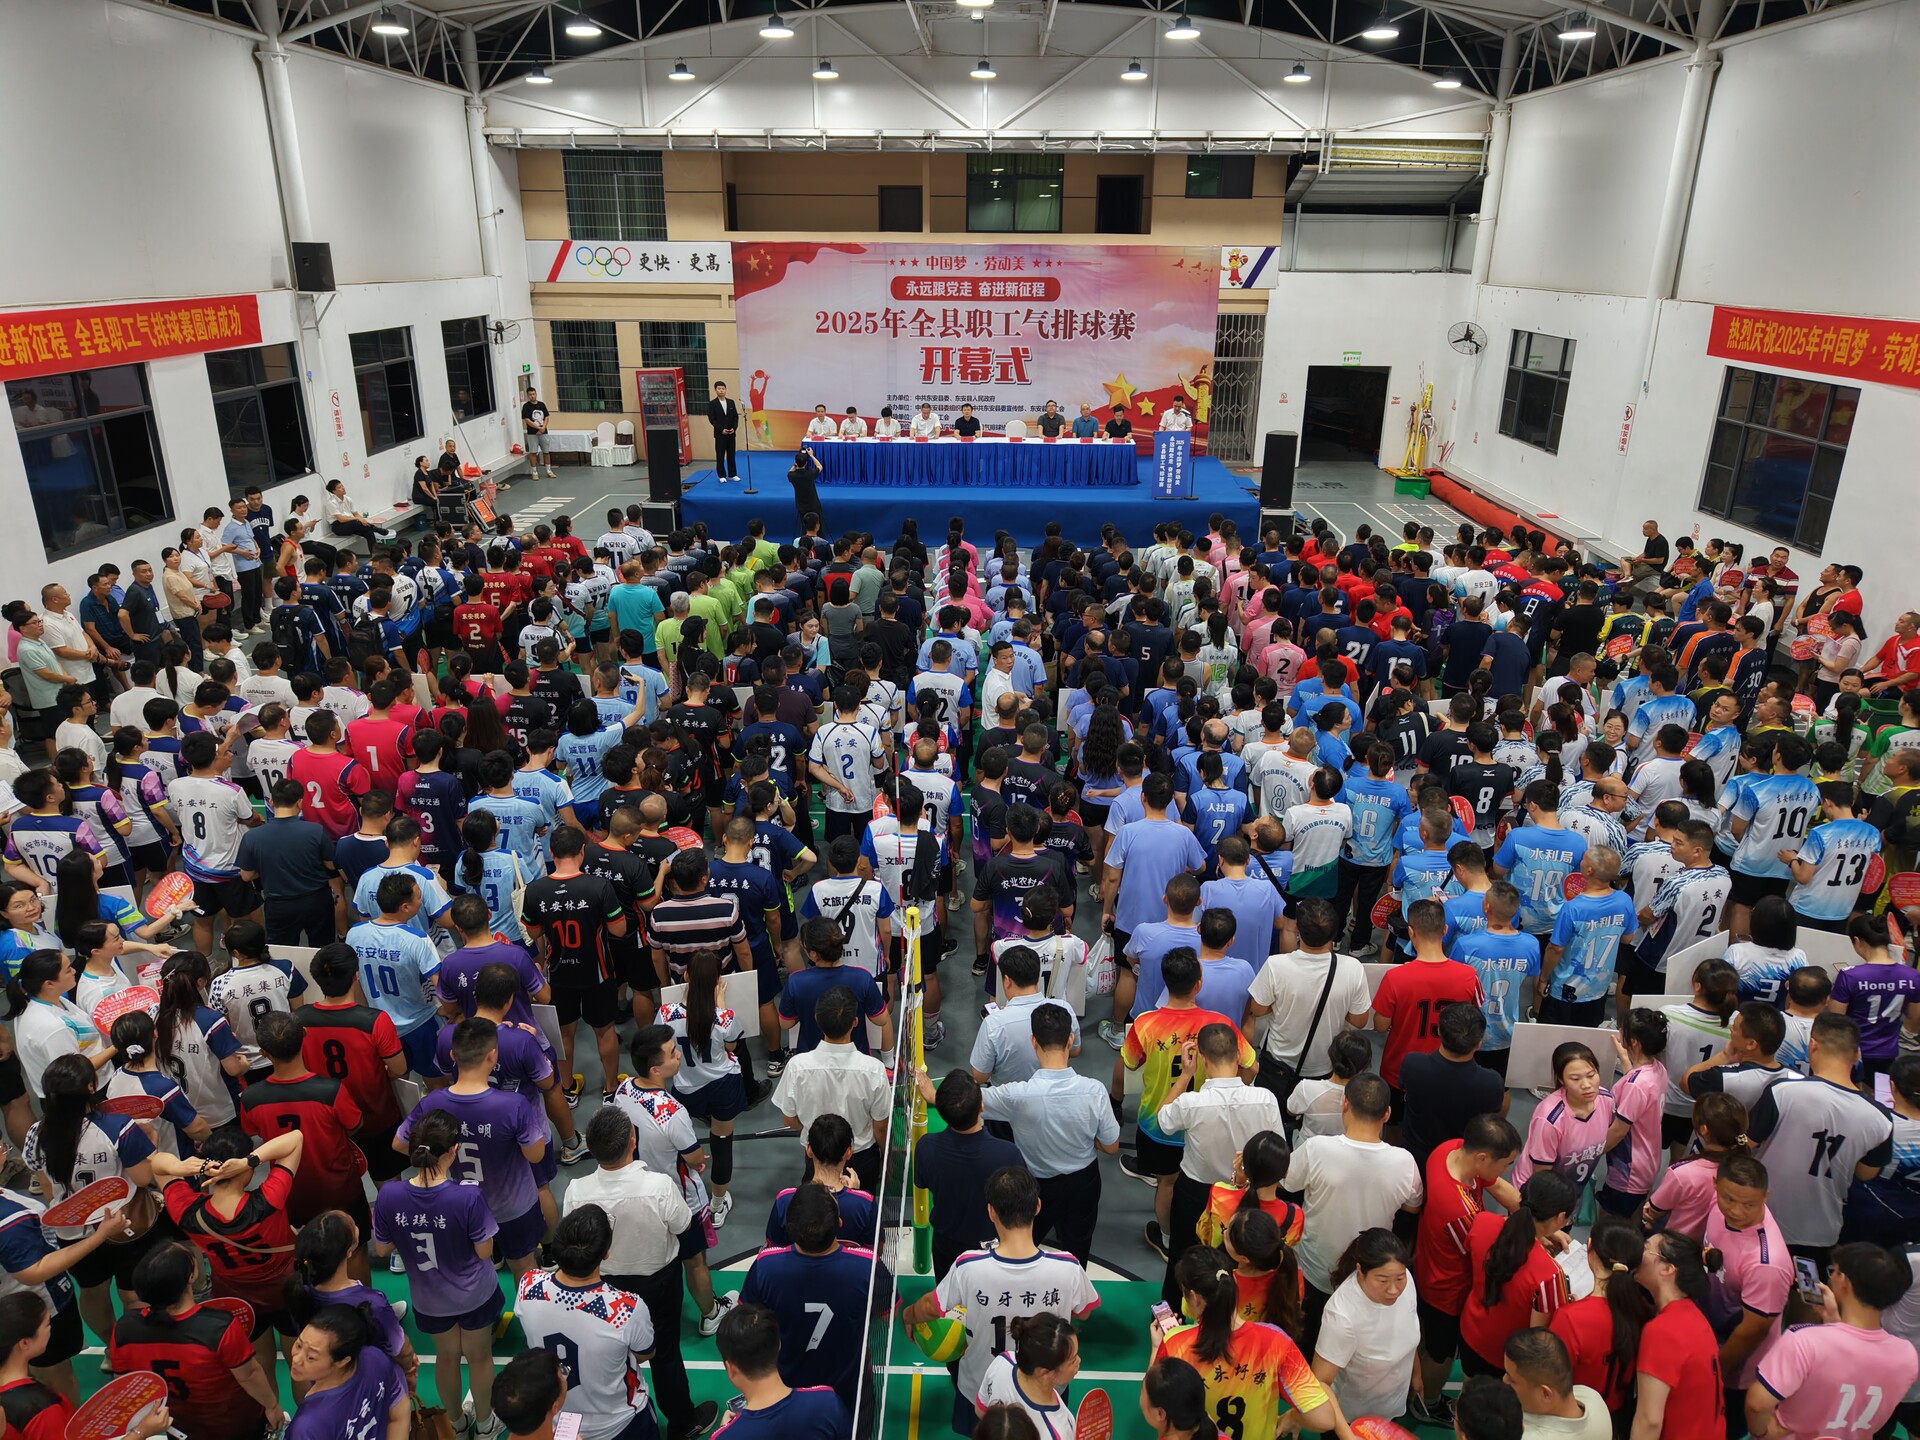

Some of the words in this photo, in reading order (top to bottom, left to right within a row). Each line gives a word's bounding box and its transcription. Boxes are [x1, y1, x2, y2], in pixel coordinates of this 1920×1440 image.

[905, 281, 973, 297] 永远跟党走
[978, 281, 1046, 297] 奋进新征程
[74, 304, 243, 357] 全县职工气排球赛圆满成功
[814, 307, 1136, 341] 2025年全县职工气排球赛
[1726, 316, 1920, 376] 热烈庆祝2025年中国梦·劳动
[919, 345, 1033, 385] 开幕式
[403, 594, 413, 614] 7
[468, 623, 482, 640] 2
[1140, 645, 1151, 662] 5
[1277, 657, 1292, 675] 2
[1346, 641, 1370, 665] 21
[1210, 663, 1227, 681] 12
[938, 697, 950, 721] 2
[834, 738, 858, 748] 东安
[1399, 730, 1417, 755] 11
[366, 745, 380, 772] 1
[576, 757, 598, 778] 11
[840, 753, 854, 780] 2
[306, 781, 326, 808] 2
[1206, 802, 1235, 814] 人社局
[1271, 784, 1287, 812] 8
[1355, 793, 1391, 808] 水利局
[1476, 786, 1495, 814] 8
[193, 811, 207, 840] 8
[420, 811, 435, 834] 3
[1210, 819, 1226, 845] 2
[1359, 809, 1378, 838] 6
[1772, 806, 1808, 840] 10
[1528, 848, 1574, 864] 水利局
[1826, 853, 1868, 887] 13
[539, 900, 590, 912] 东安林业
[1584, 914, 1625, 932] 水利局
[1695, 904, 1717, 937] 2
[551, 920, 582, 949] 10
[355, 946, 401, 962] 东安城管
[1481, 958, 1528, 972] 水利局
[227, 975, 286, 1001] 发展集团
[364, 963, 400, 999] 10
[1753, 978, 1781, 1002] 3
[1858, 980, 1895, 992] Hong
[1488, 979, 1510, 1016] 3
[1866, 994, 1906, 1025] 14
[323, 1039, 348, 1079] 8
[457, 1142, 484, 1182] 5
[1576, 1163, 1589, 1182] 9
[206, 1239, 273, 1271] 15
[410, 1232, 440, 1272] 3
[975, 1287, 1061, 1309] 白牙市镇
[804, 1302, 834, 1353] 7
[149, 1359, 191, 1401] 5
[1216, 1395, 1247, 1440] 8
[1825, 1383, 1884, 1430] 11
